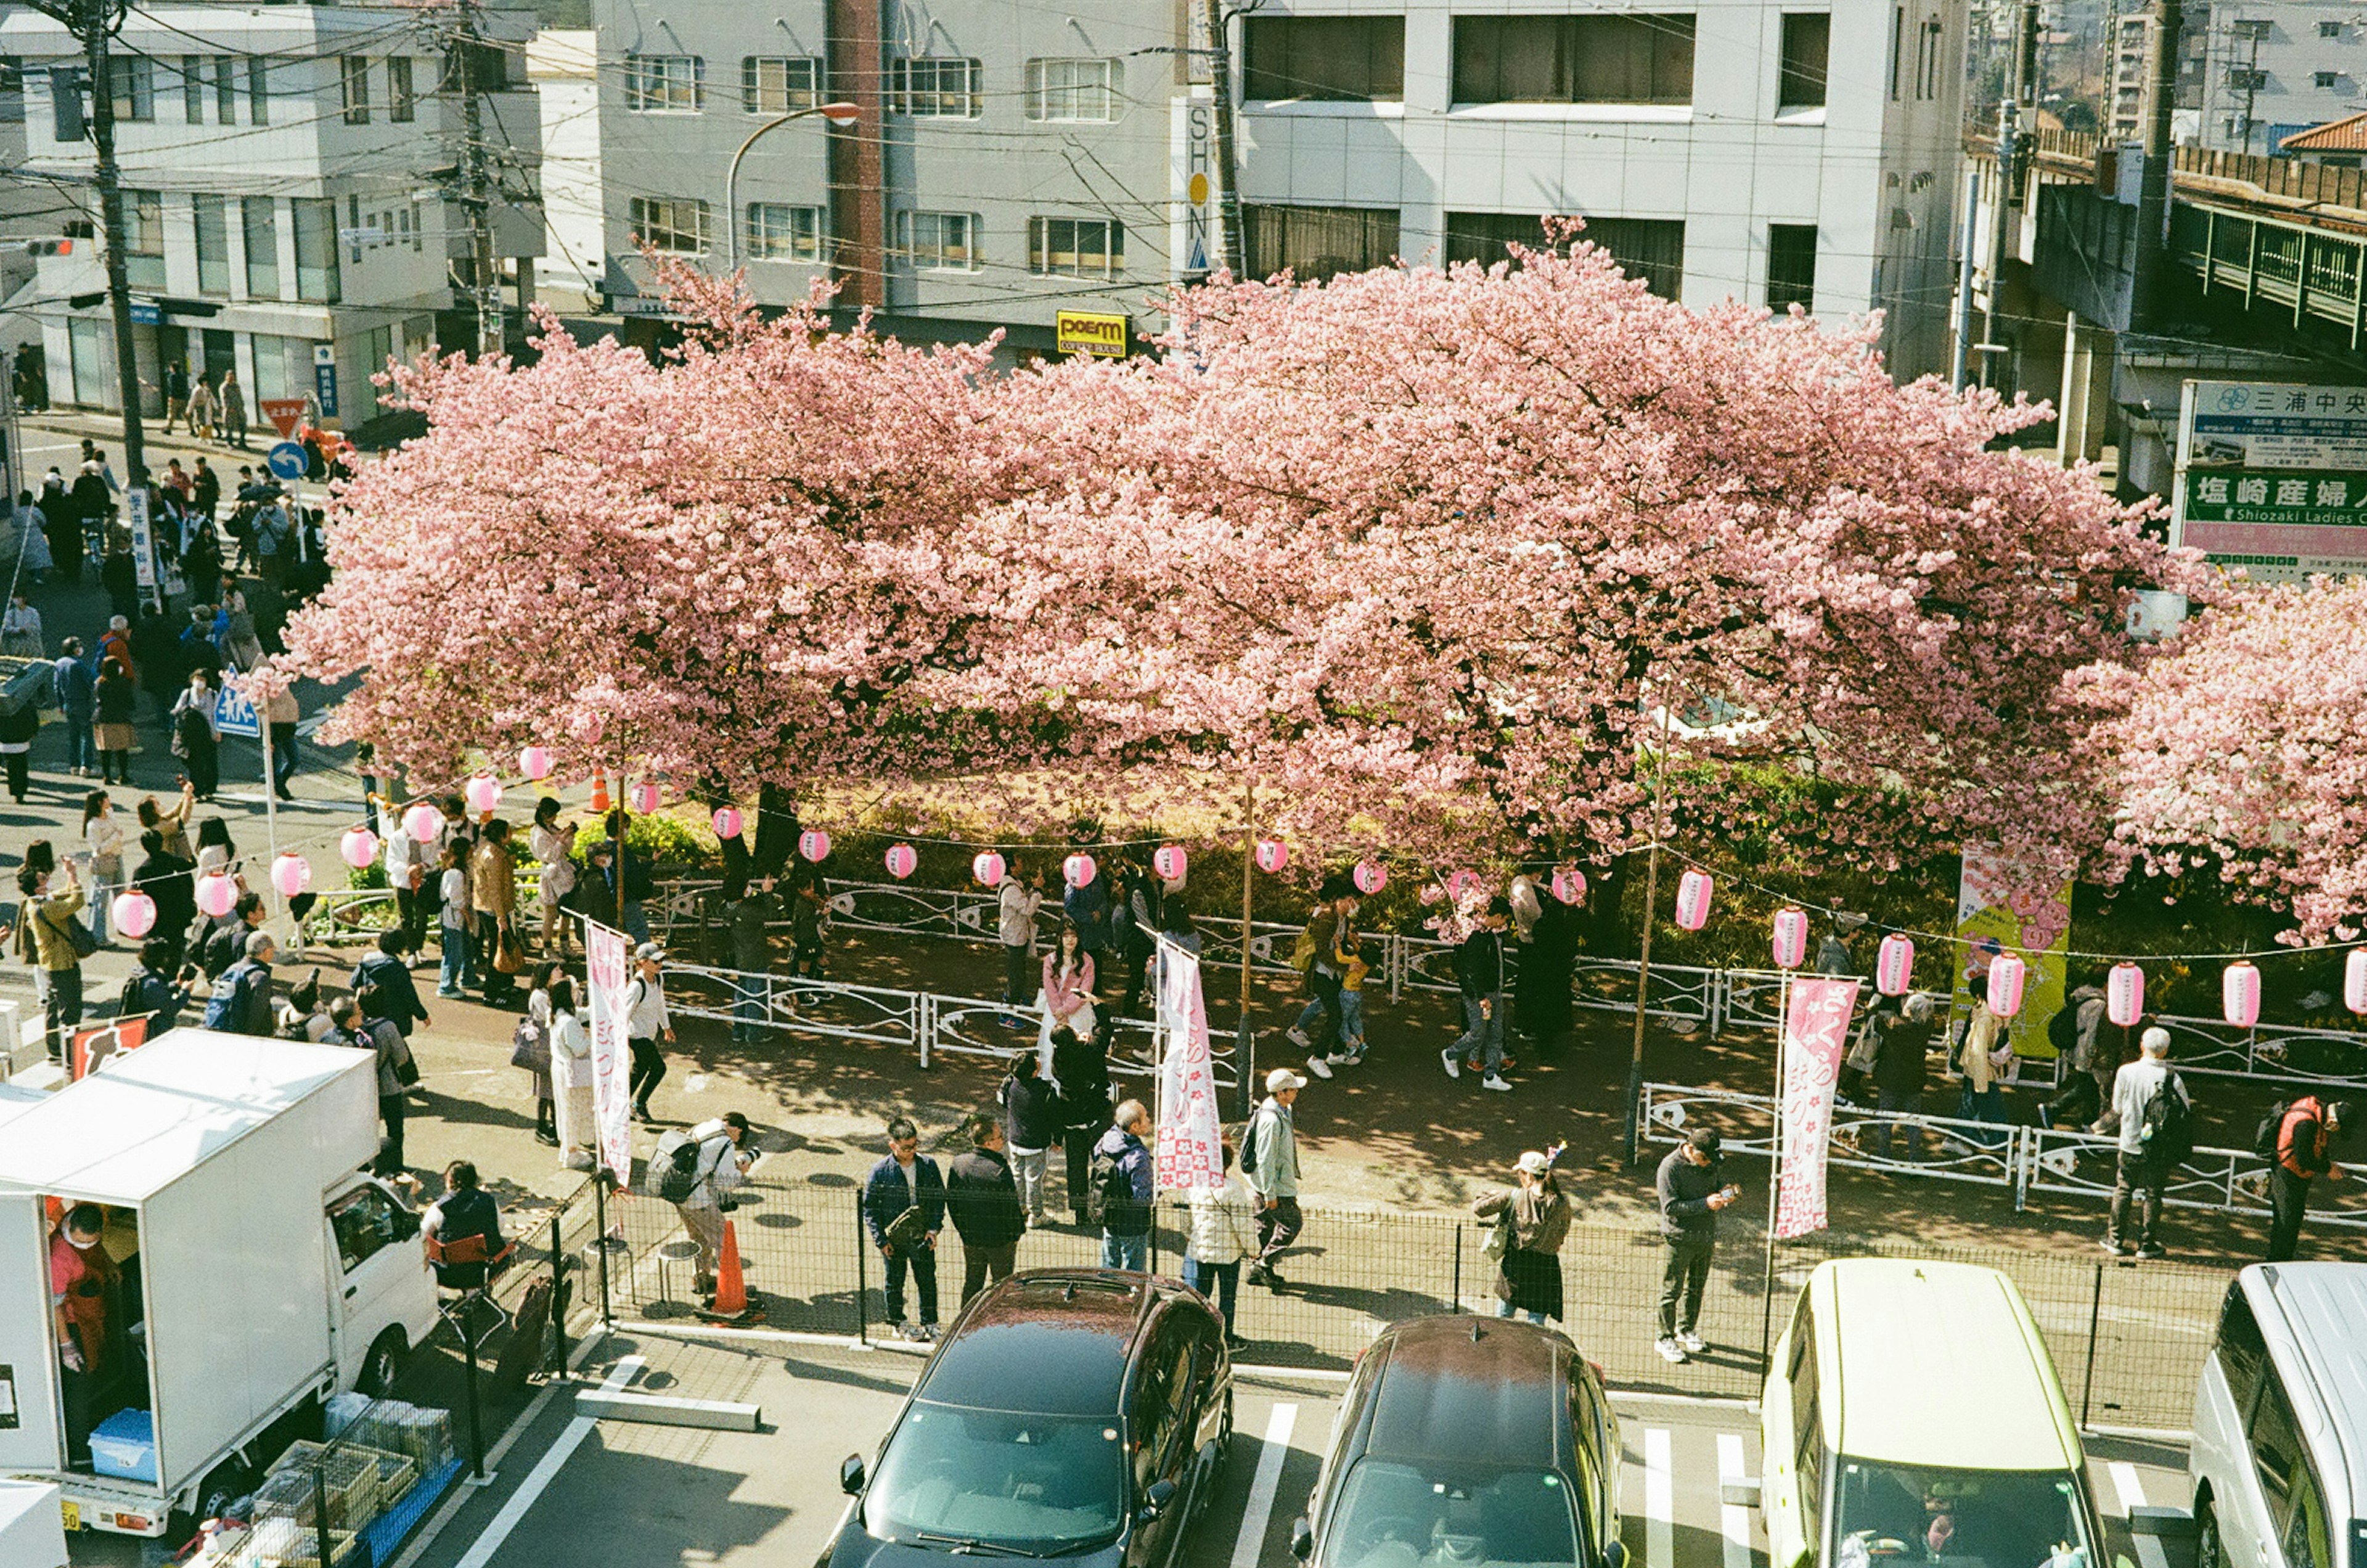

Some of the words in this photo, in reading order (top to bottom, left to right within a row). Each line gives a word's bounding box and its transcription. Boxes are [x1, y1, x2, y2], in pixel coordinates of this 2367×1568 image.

[1095, 344, 1122, 354] HOUSE
[2255, 390, 2367, 414] 三浦中央
[2236, 508, 2299, 523] Shiozaki
[2305, 511, 2353, 525] Ladies
[1813, 985, 1849, 1087] さくら
